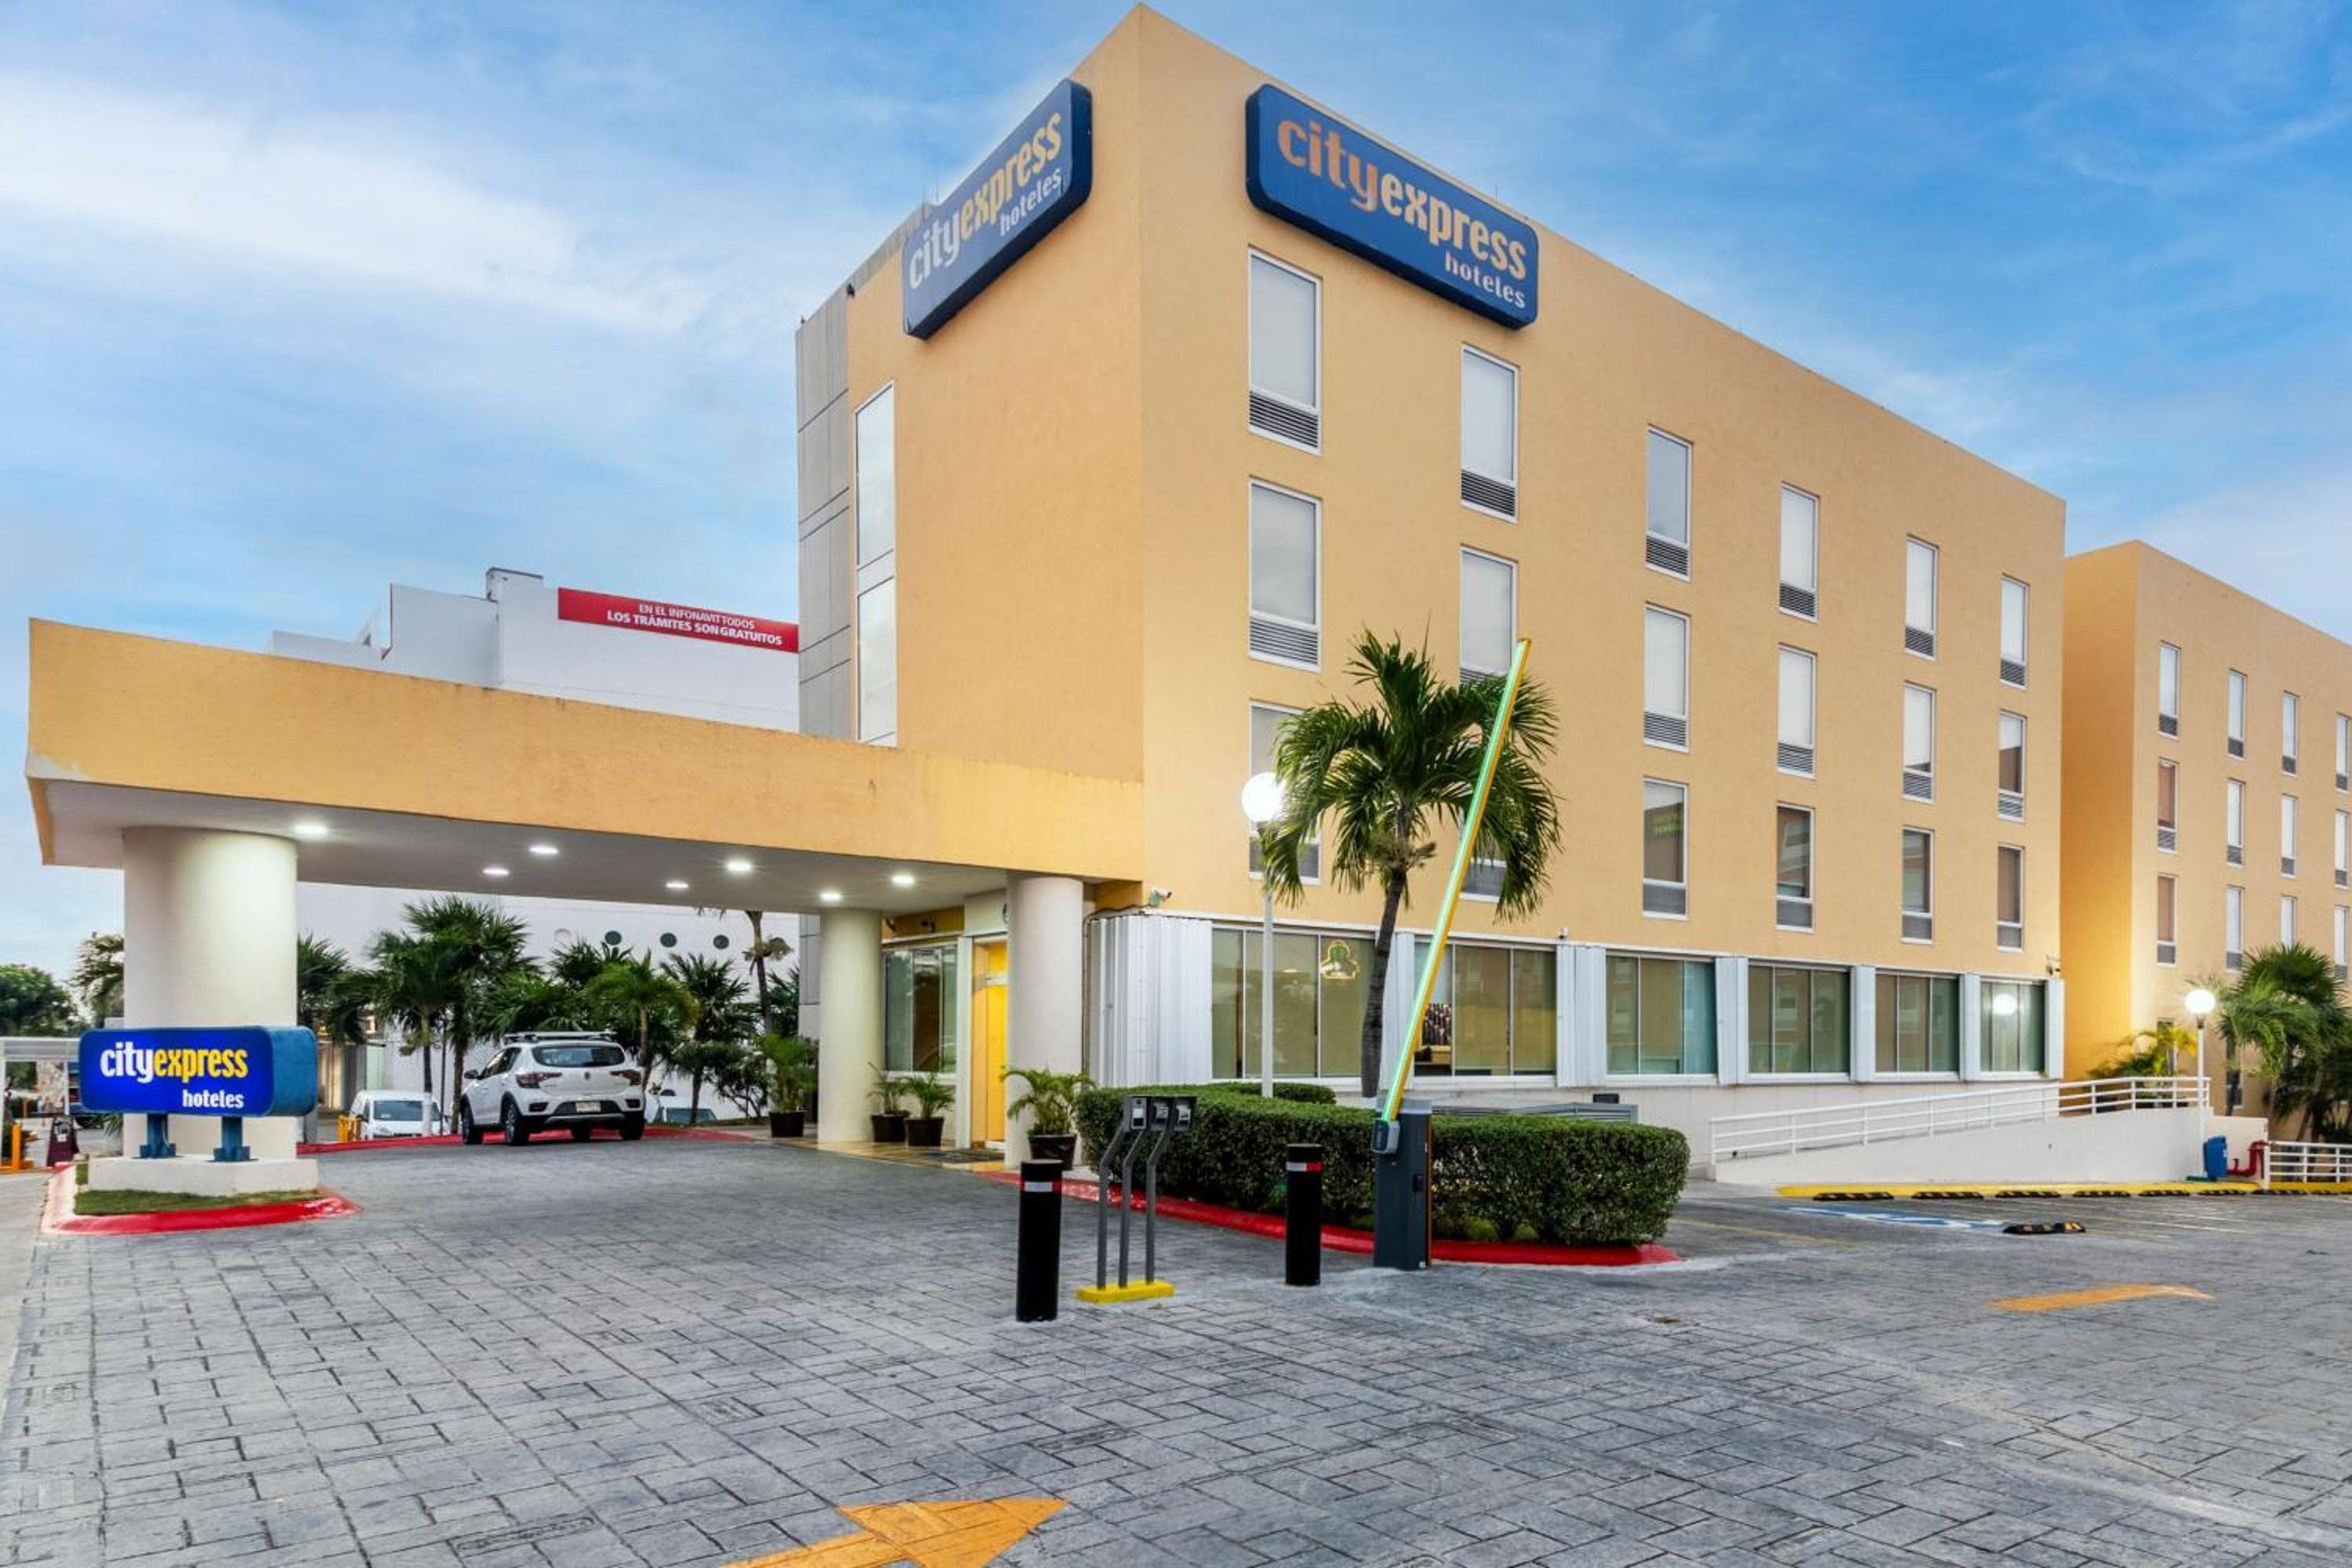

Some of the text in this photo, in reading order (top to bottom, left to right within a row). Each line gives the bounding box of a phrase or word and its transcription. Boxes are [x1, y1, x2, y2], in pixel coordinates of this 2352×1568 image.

[909, 112, 1061, 289] cityexpress
[1000, 167, 1062, 236] hoteles
[1277, 118, 1527, 280] cityexpress
[1445, 250, 1526, 309] hoteles
[607, 610, 631, 623] LOS
[694, 622, 719, 634] SON
[720, 626, 782, 645] GRATUITOS
[639, 603, 755, 630] EN EL INFONAVIT TODOS
[100, 1040, 249, 1083] cityexpress
[183, 1089, 245, 1109] hoteles
